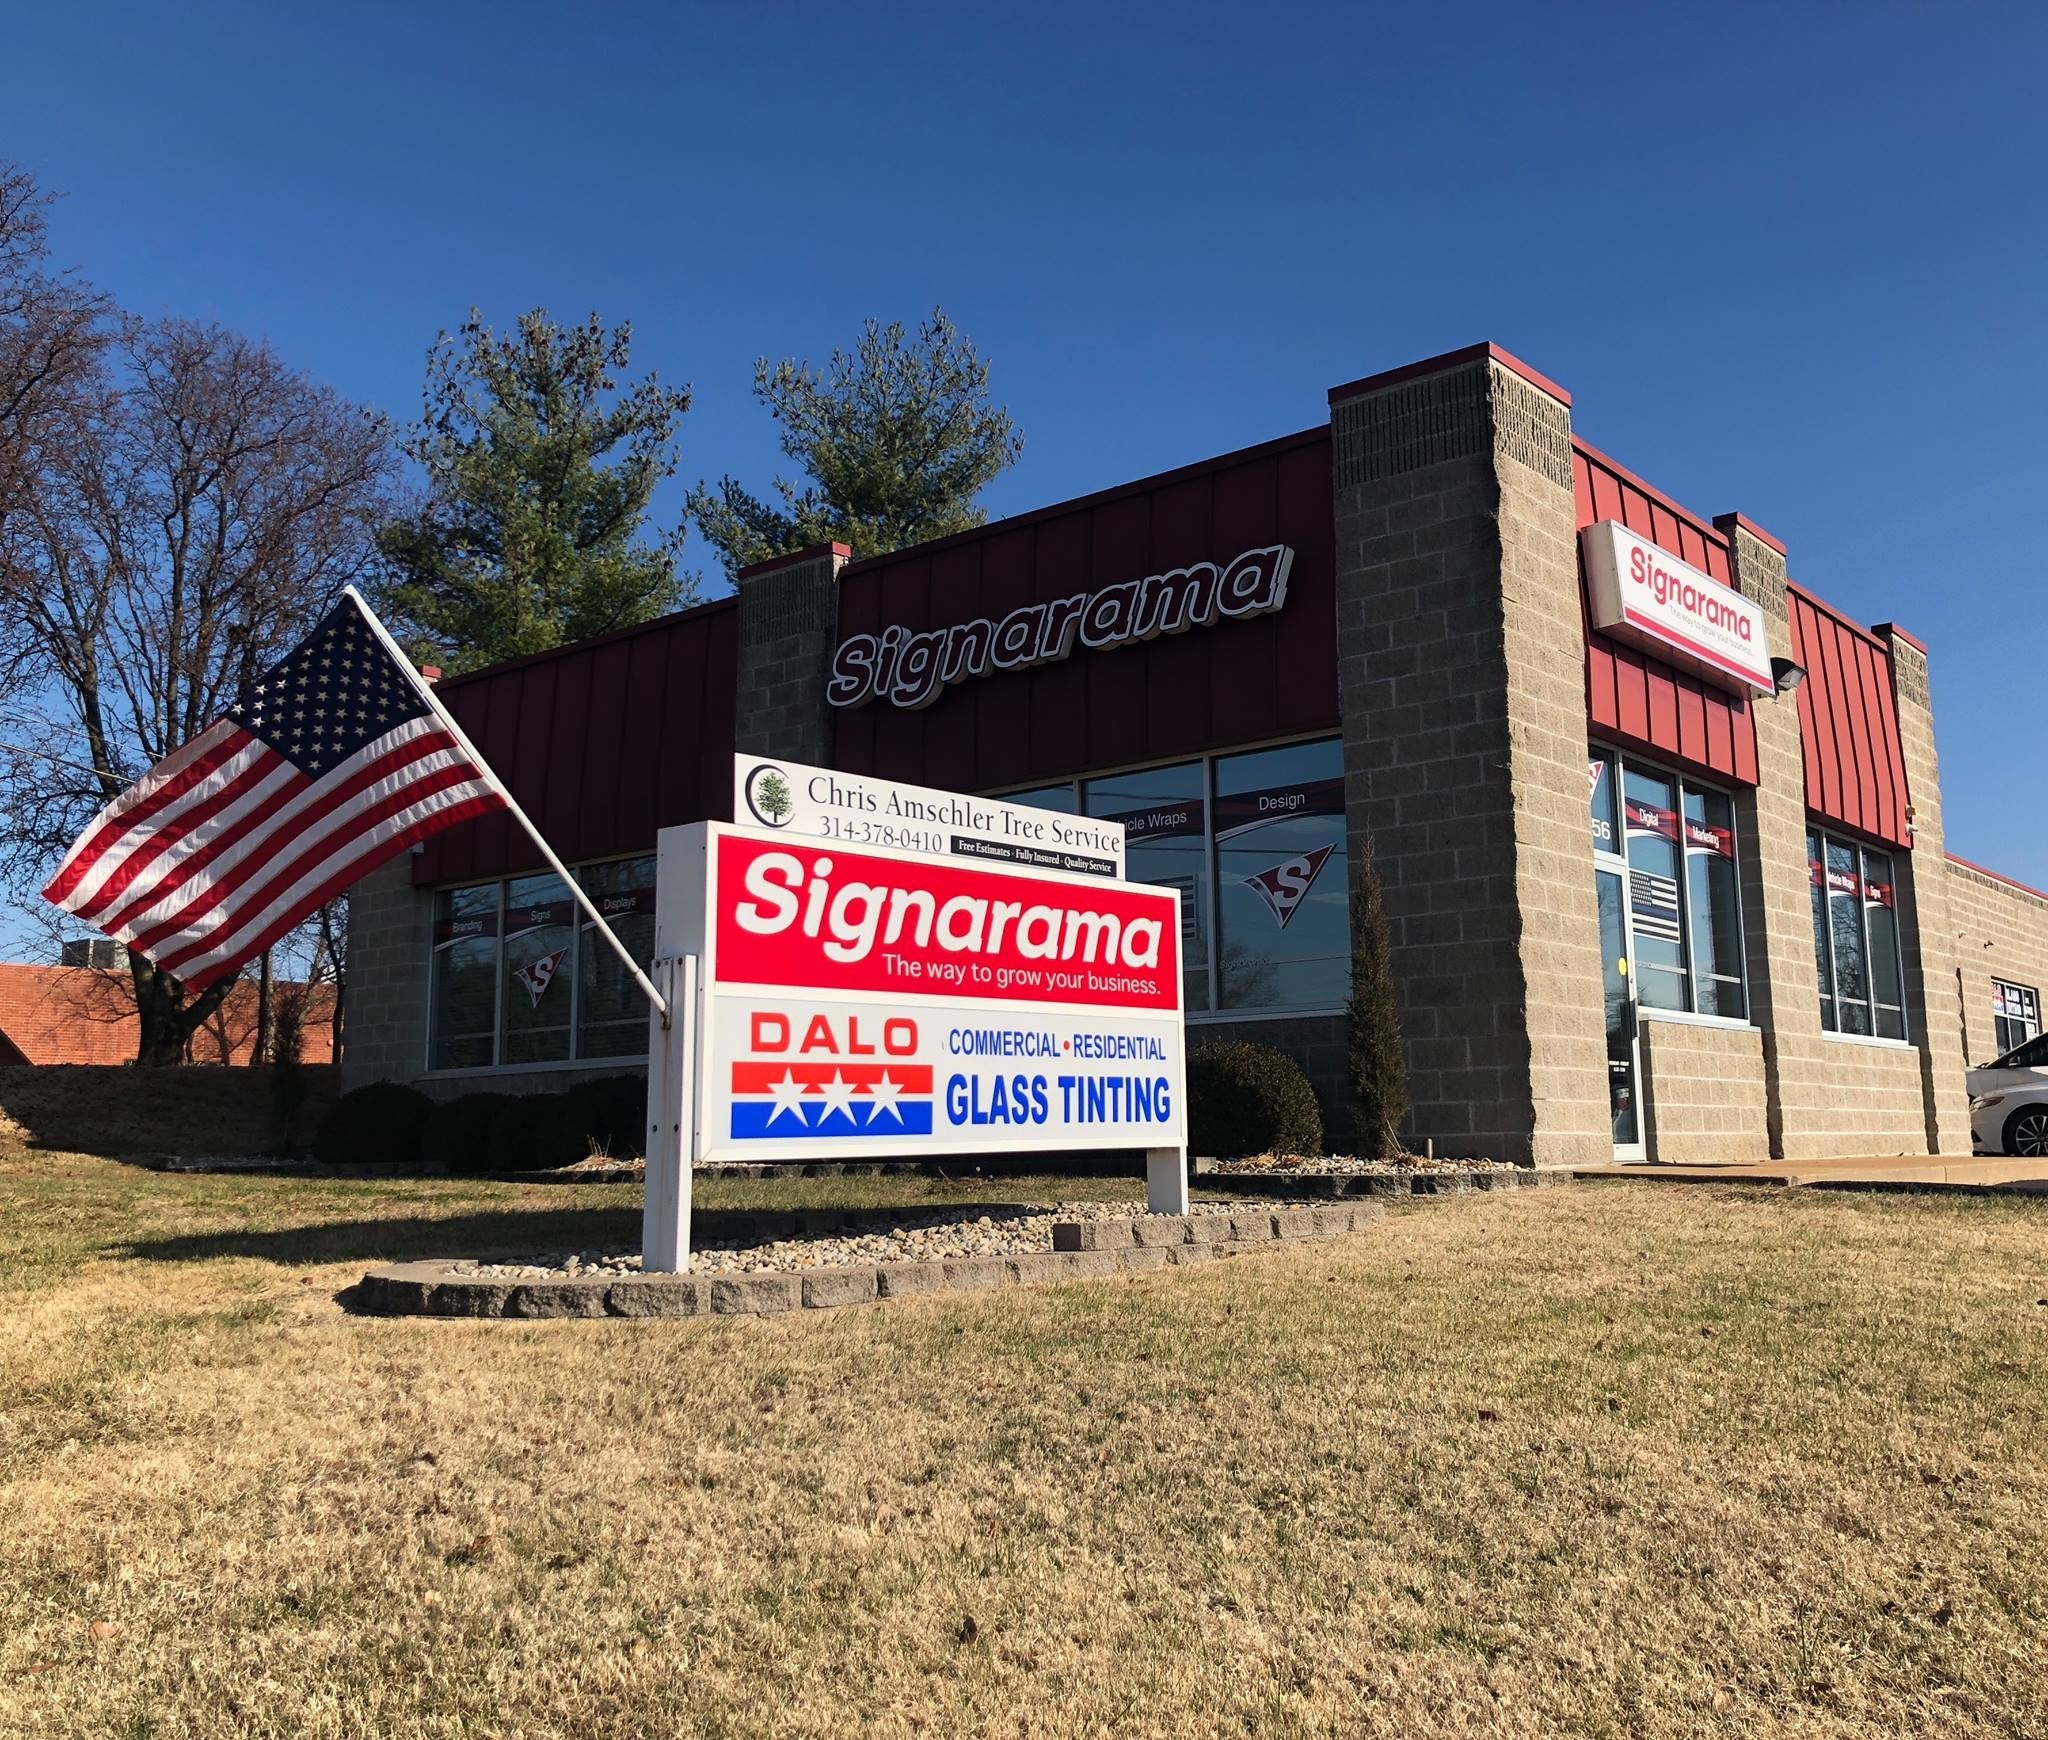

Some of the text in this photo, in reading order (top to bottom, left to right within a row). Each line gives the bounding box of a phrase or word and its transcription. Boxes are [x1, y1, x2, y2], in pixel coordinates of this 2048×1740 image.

[1630, 546, 1752, 642] Signarama
[827, 544, 1294, 709] Signarama
[808, 776, 1121, 853] Chris Amschler Tree Service
[1147, 812, 1188, 828] Wraps
[1258, 792, 1306, 811] Design
[1639, 807, 1659, 827] Digital
[819, 815, 942, 853] 314-378-0410
[1692, 825, 1720, 849] Marketing
[959, 840, 1112, 873] Free Estimates Fully Insured Quality Service
[603, 896, 637, 911] Displays
[734, 851, 1163, 969] Signarama
[882, 953, 1161, 995] The way to grow your business.
[750, 1011, 919, 1056] DALO
[949, 1027, 1167, 1061] COMMERCIAL RESIDENTIAL
[945, 1073, 1171, 1126] GLASS TINTING
